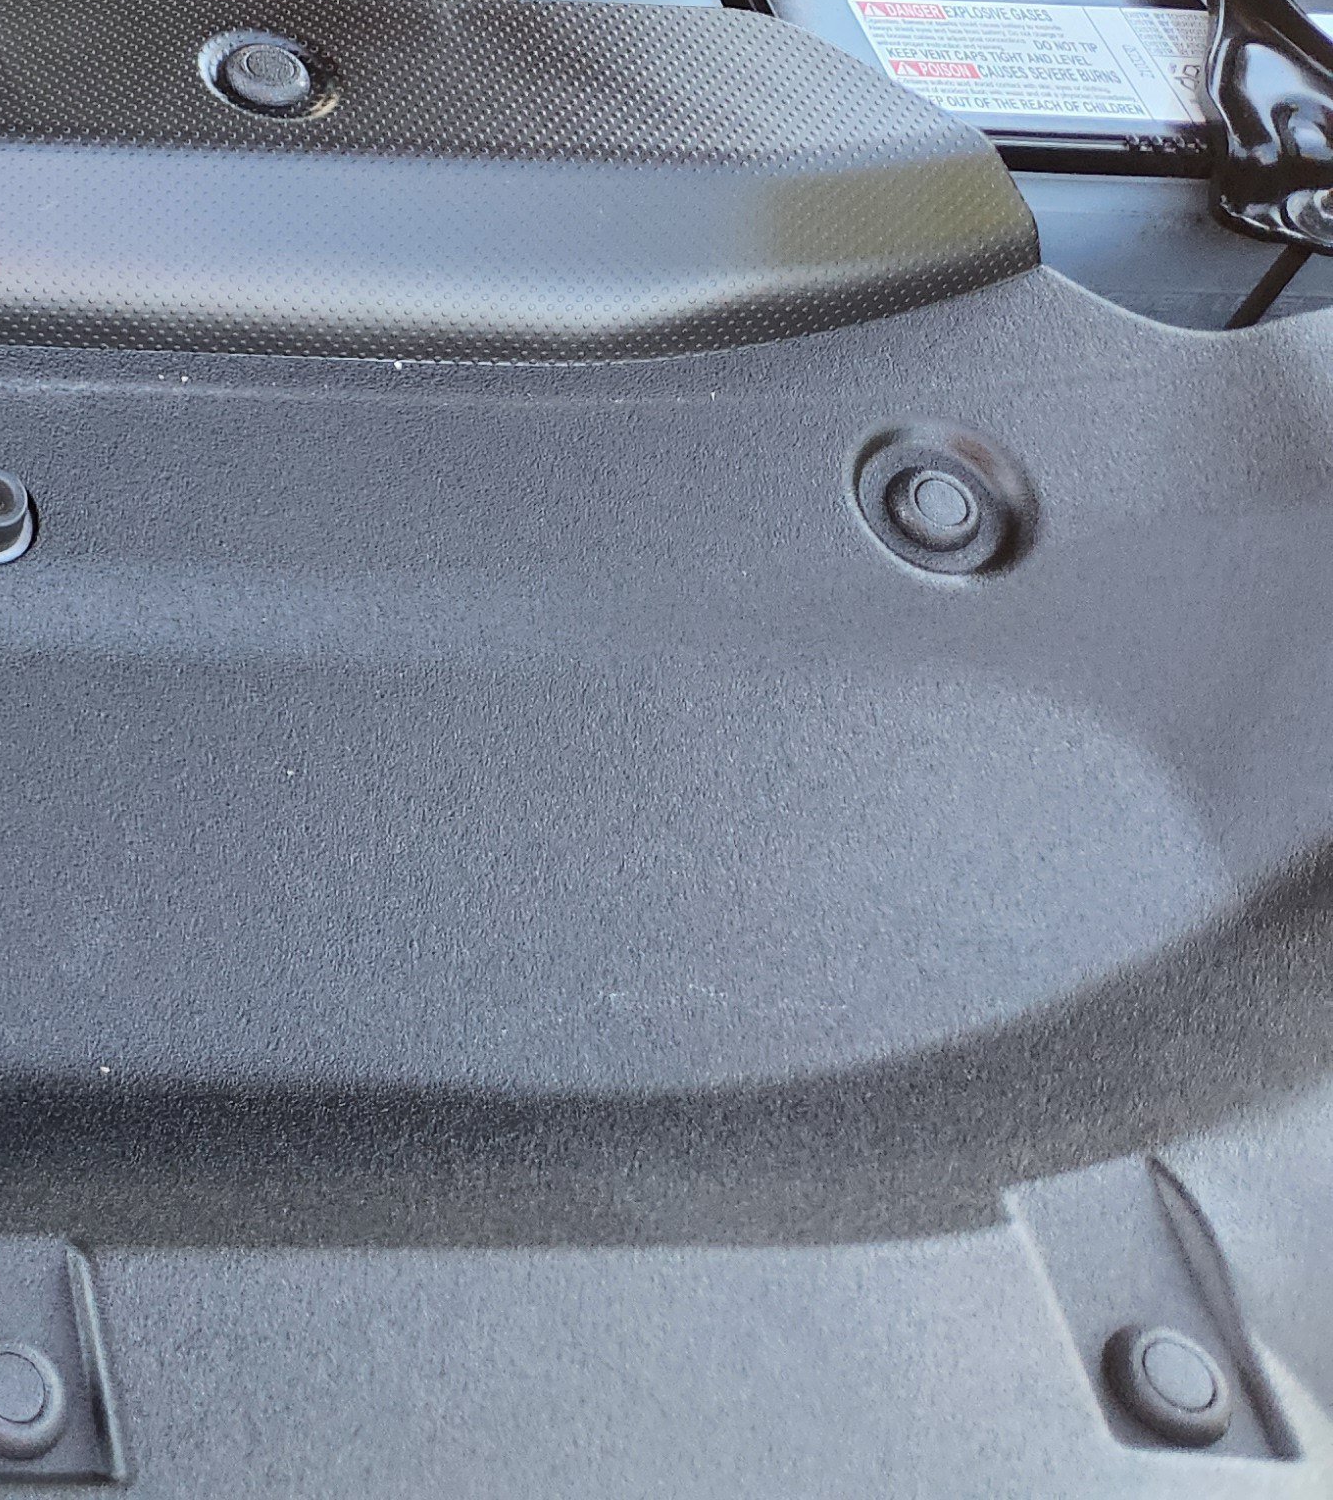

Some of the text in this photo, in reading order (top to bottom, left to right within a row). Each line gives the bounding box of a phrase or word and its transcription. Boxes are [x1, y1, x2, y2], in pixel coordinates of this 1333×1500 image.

[885, 3, 1053, 22] DANGER EXPLOSIVE GASES
[1035, 40, 1099, 53] DO NOT TIP
[888, 48, 1093, 66] KEEP VENT CAPS TIGHT AND LEVEL
[917, 62, 1122, 84] POISON CAUSES SEVERE BURNS
[943, 96, 971, 108] OUT
[973, 97, 991, 109] OF
[993, 98, 1019, 110] THE
[1019, 98, 1063, 111] REACH
[1064, 100, 1082, 112] OF
[1082, 101, 1145, 115] CHILDREN
